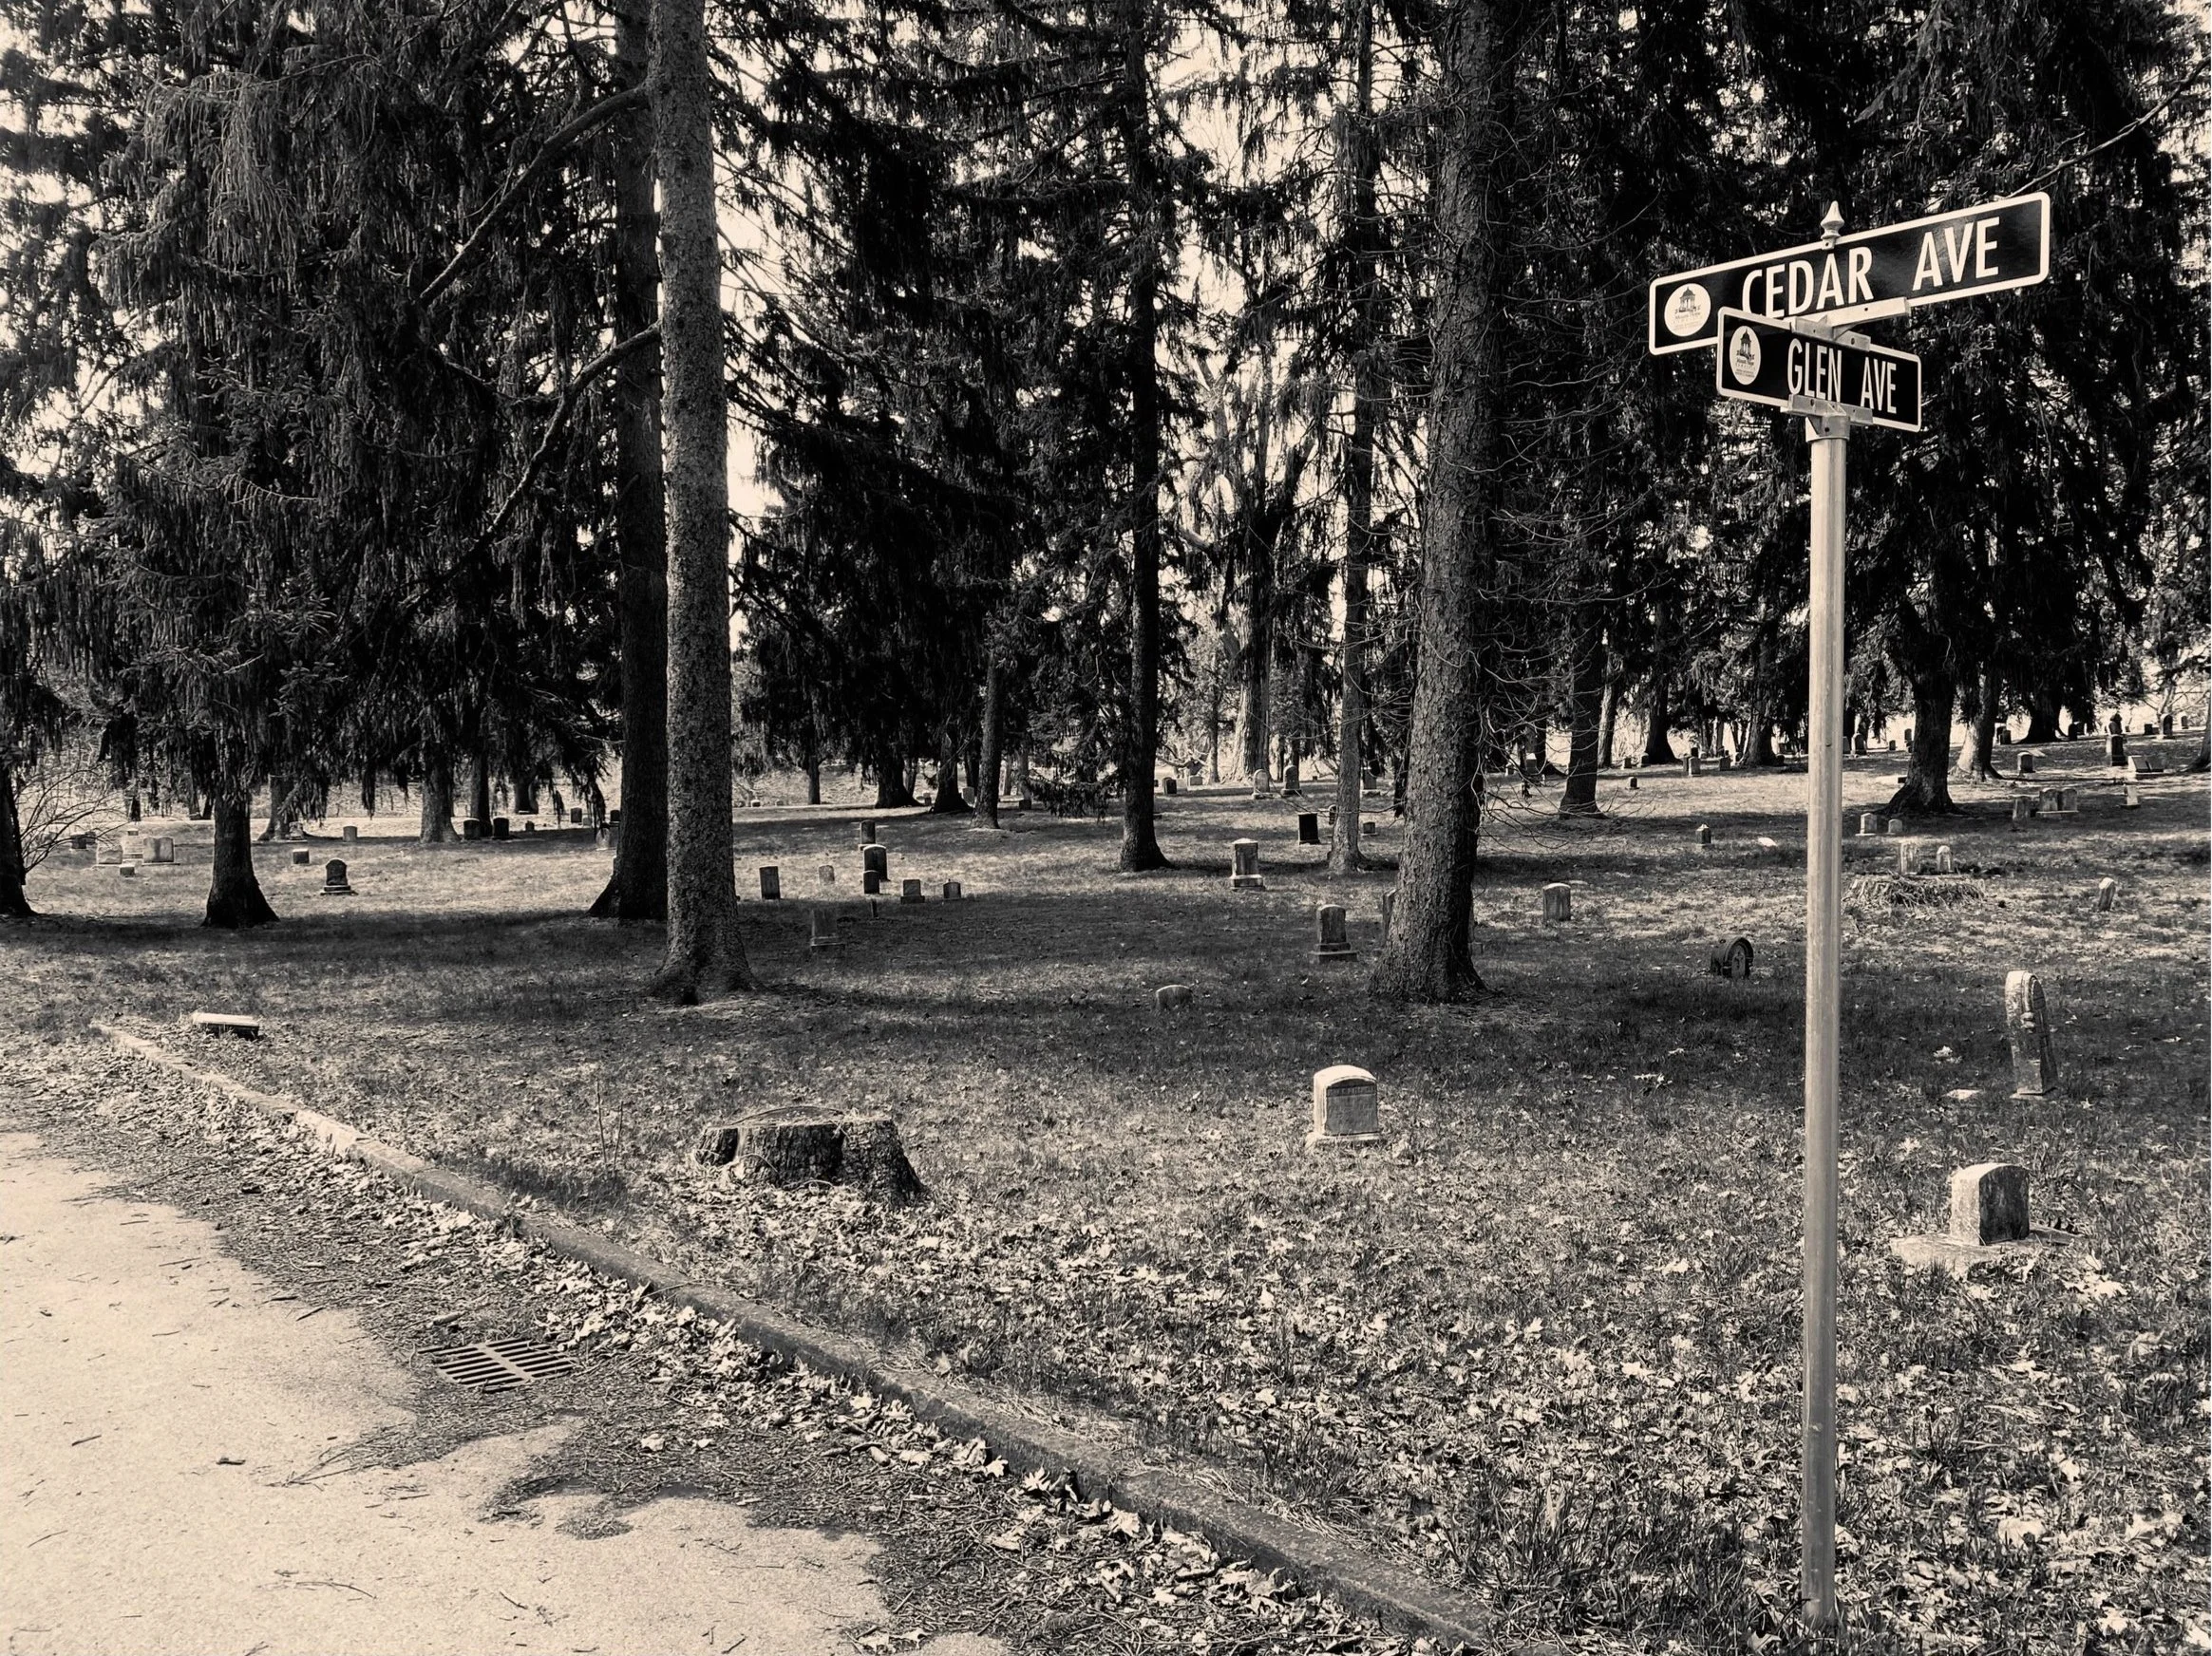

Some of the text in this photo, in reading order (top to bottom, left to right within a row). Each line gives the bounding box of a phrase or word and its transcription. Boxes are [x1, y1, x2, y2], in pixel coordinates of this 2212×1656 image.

[1742, 216, 2000, 319] CEDAR AVE
[1787, 338, 1897, 414] GLEN AVE
